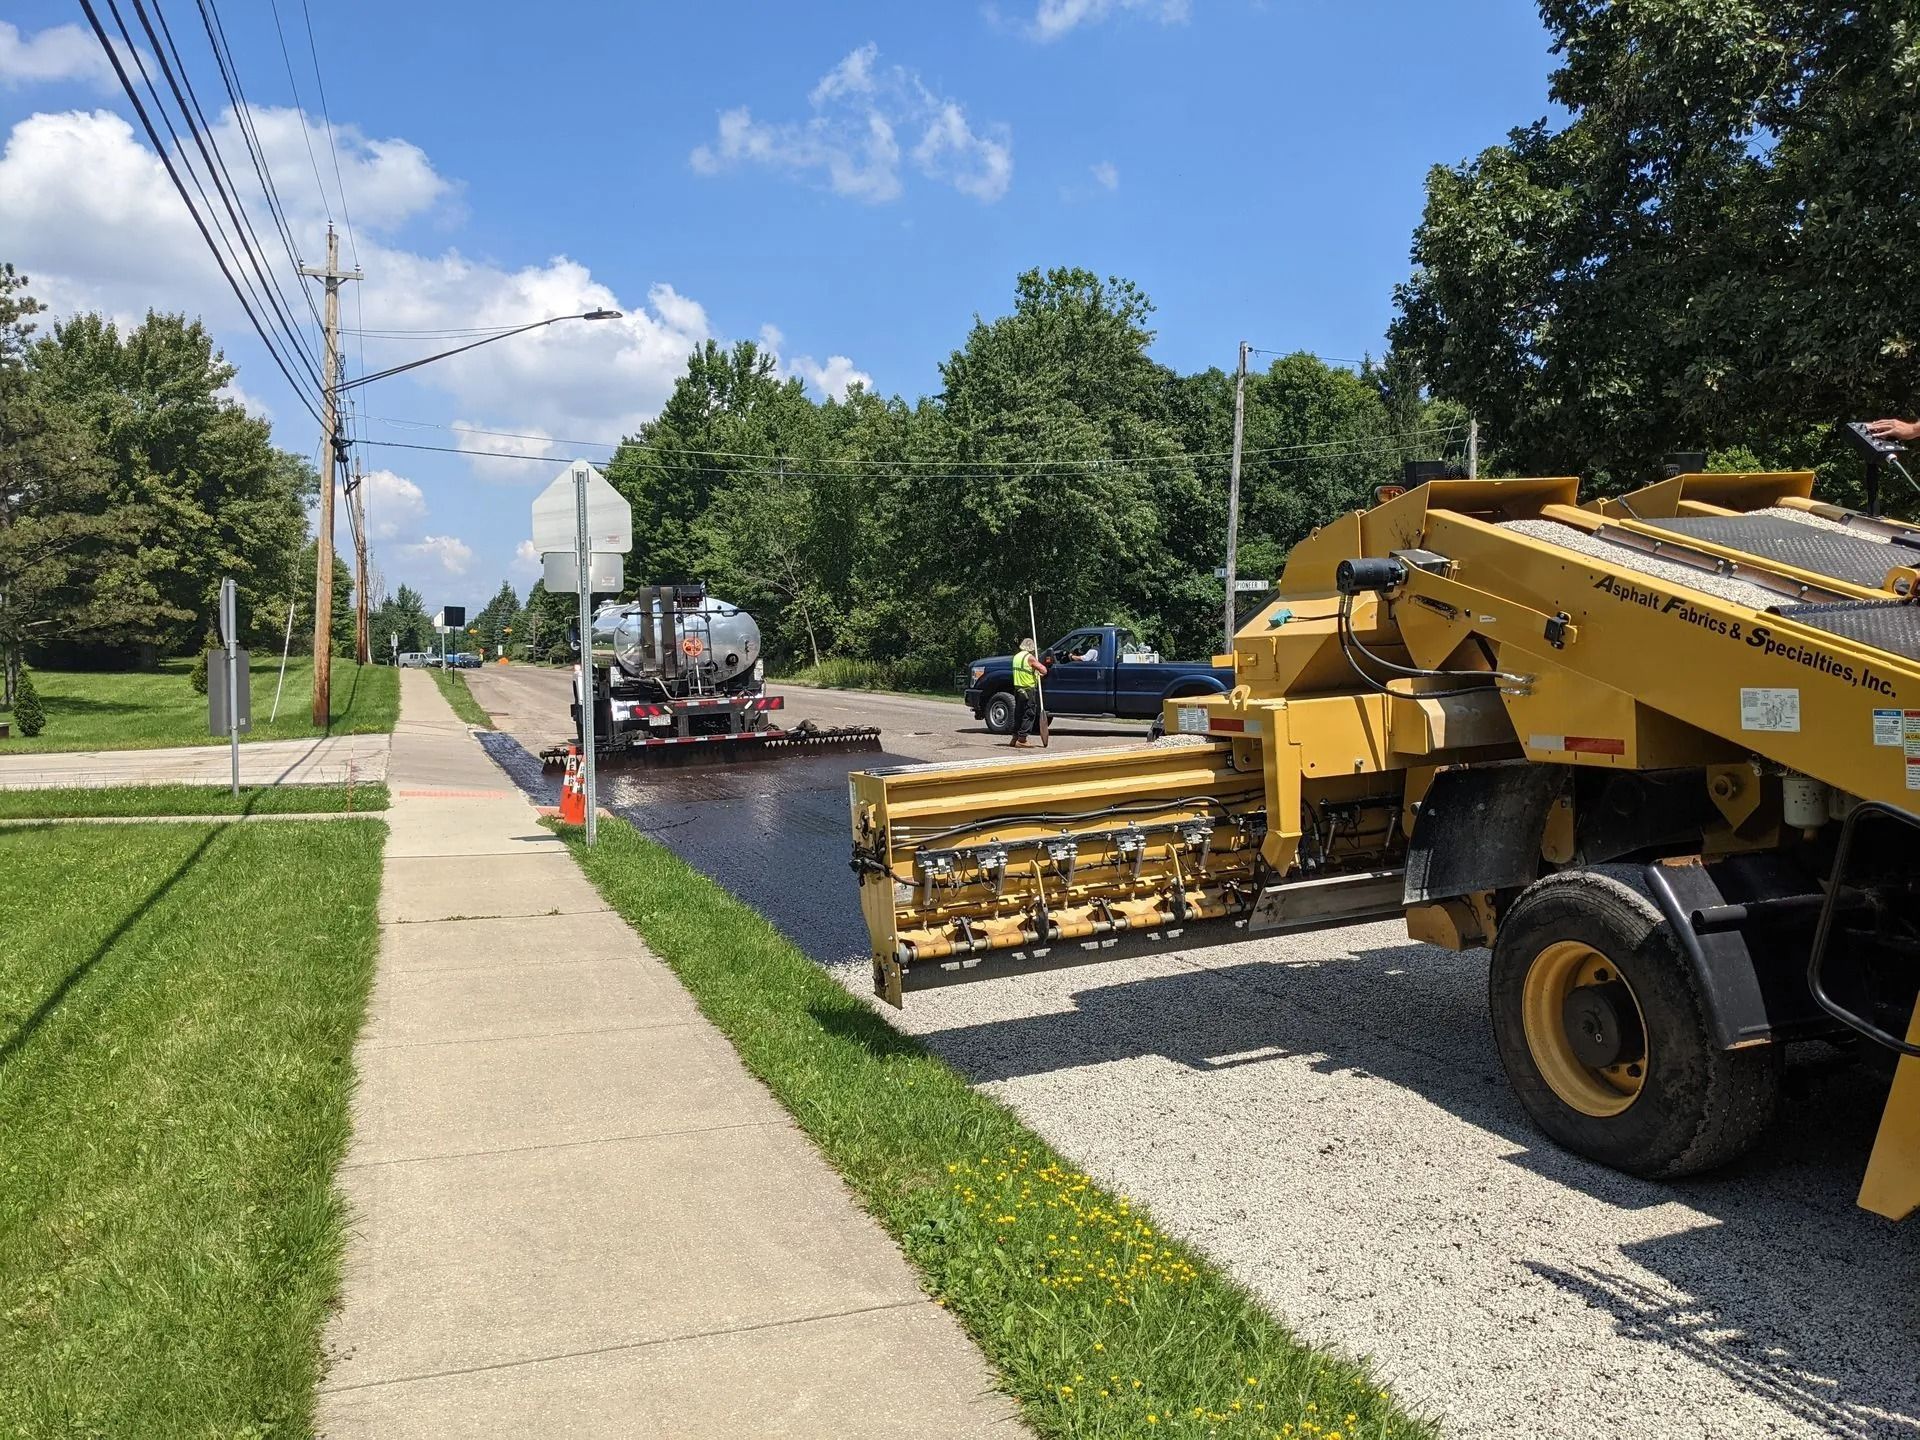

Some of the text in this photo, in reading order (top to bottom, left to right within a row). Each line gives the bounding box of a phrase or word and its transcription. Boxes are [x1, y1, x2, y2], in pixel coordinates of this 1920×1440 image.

[1237, 581, 1258, 589] PIONEER
[1593, 575, 1897, 698] Asphalt Fabrics & Specialties, Inc.
